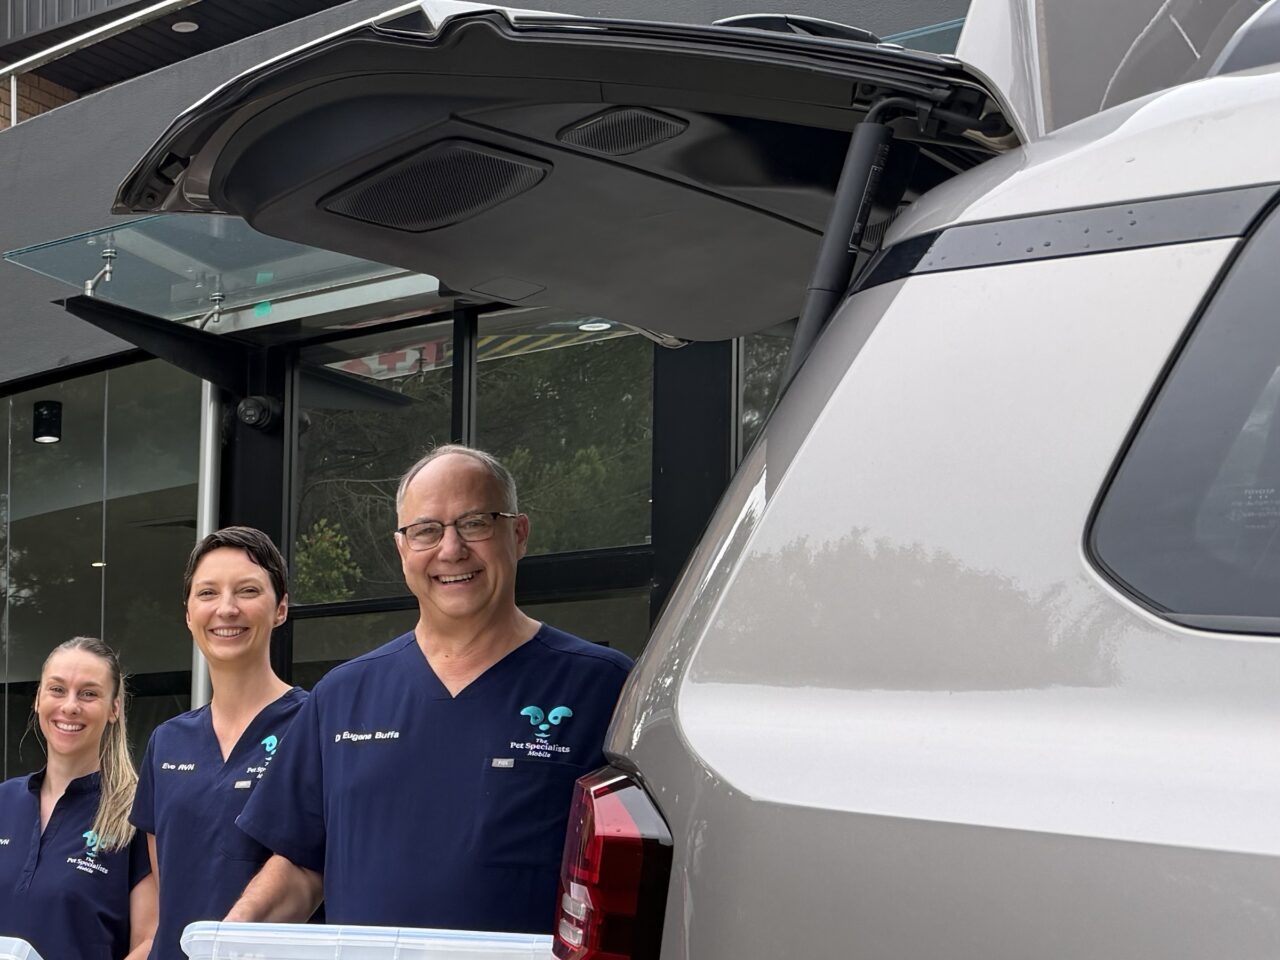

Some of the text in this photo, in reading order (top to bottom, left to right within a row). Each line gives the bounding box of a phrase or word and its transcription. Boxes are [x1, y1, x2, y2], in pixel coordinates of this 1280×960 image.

[375, 731, 399, 739] Buffa
[525, 742, 570, 753] Specialists
[527, 750, 551, 758] Mobile
